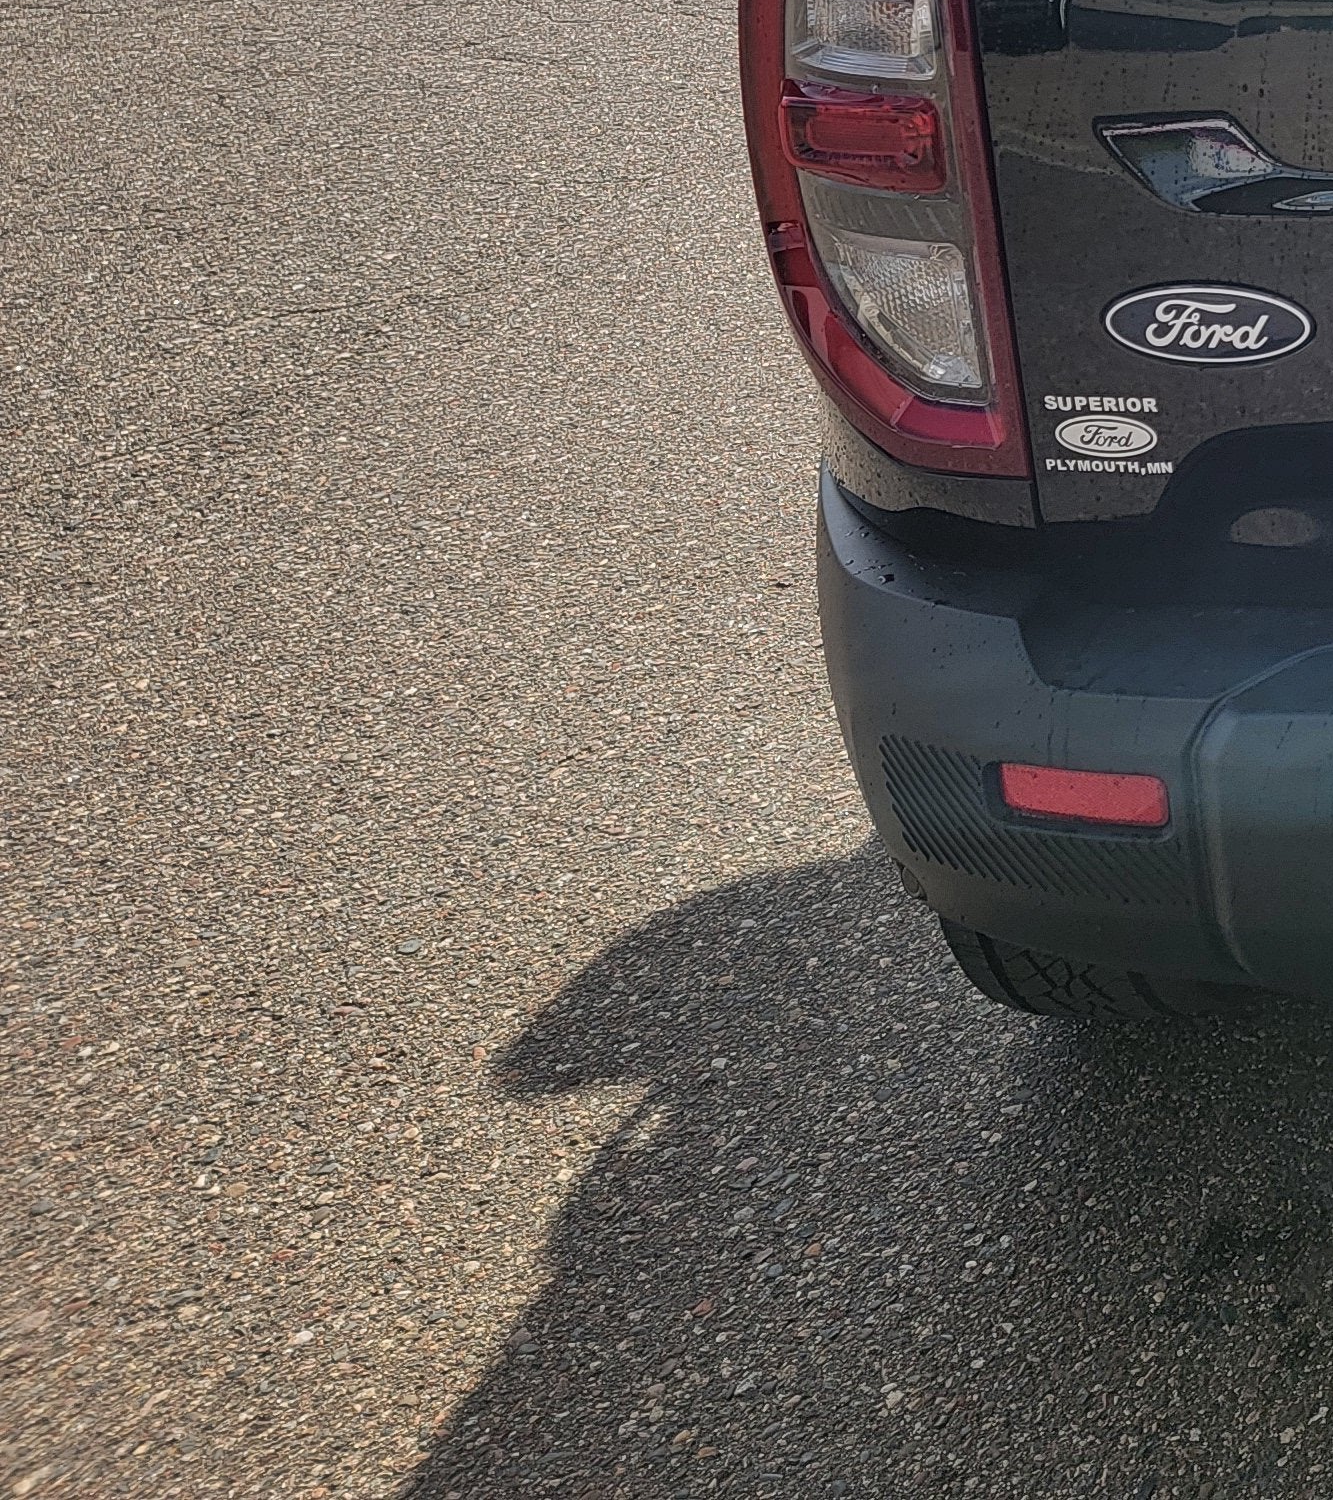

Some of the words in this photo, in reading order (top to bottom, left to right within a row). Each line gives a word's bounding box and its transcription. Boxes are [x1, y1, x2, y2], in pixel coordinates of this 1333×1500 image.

[1145, 299, 1270, 349] Ford
[1043, 395, 1158, 413] SUPERIOR
[1079, 425, 1134, 448] Ford
